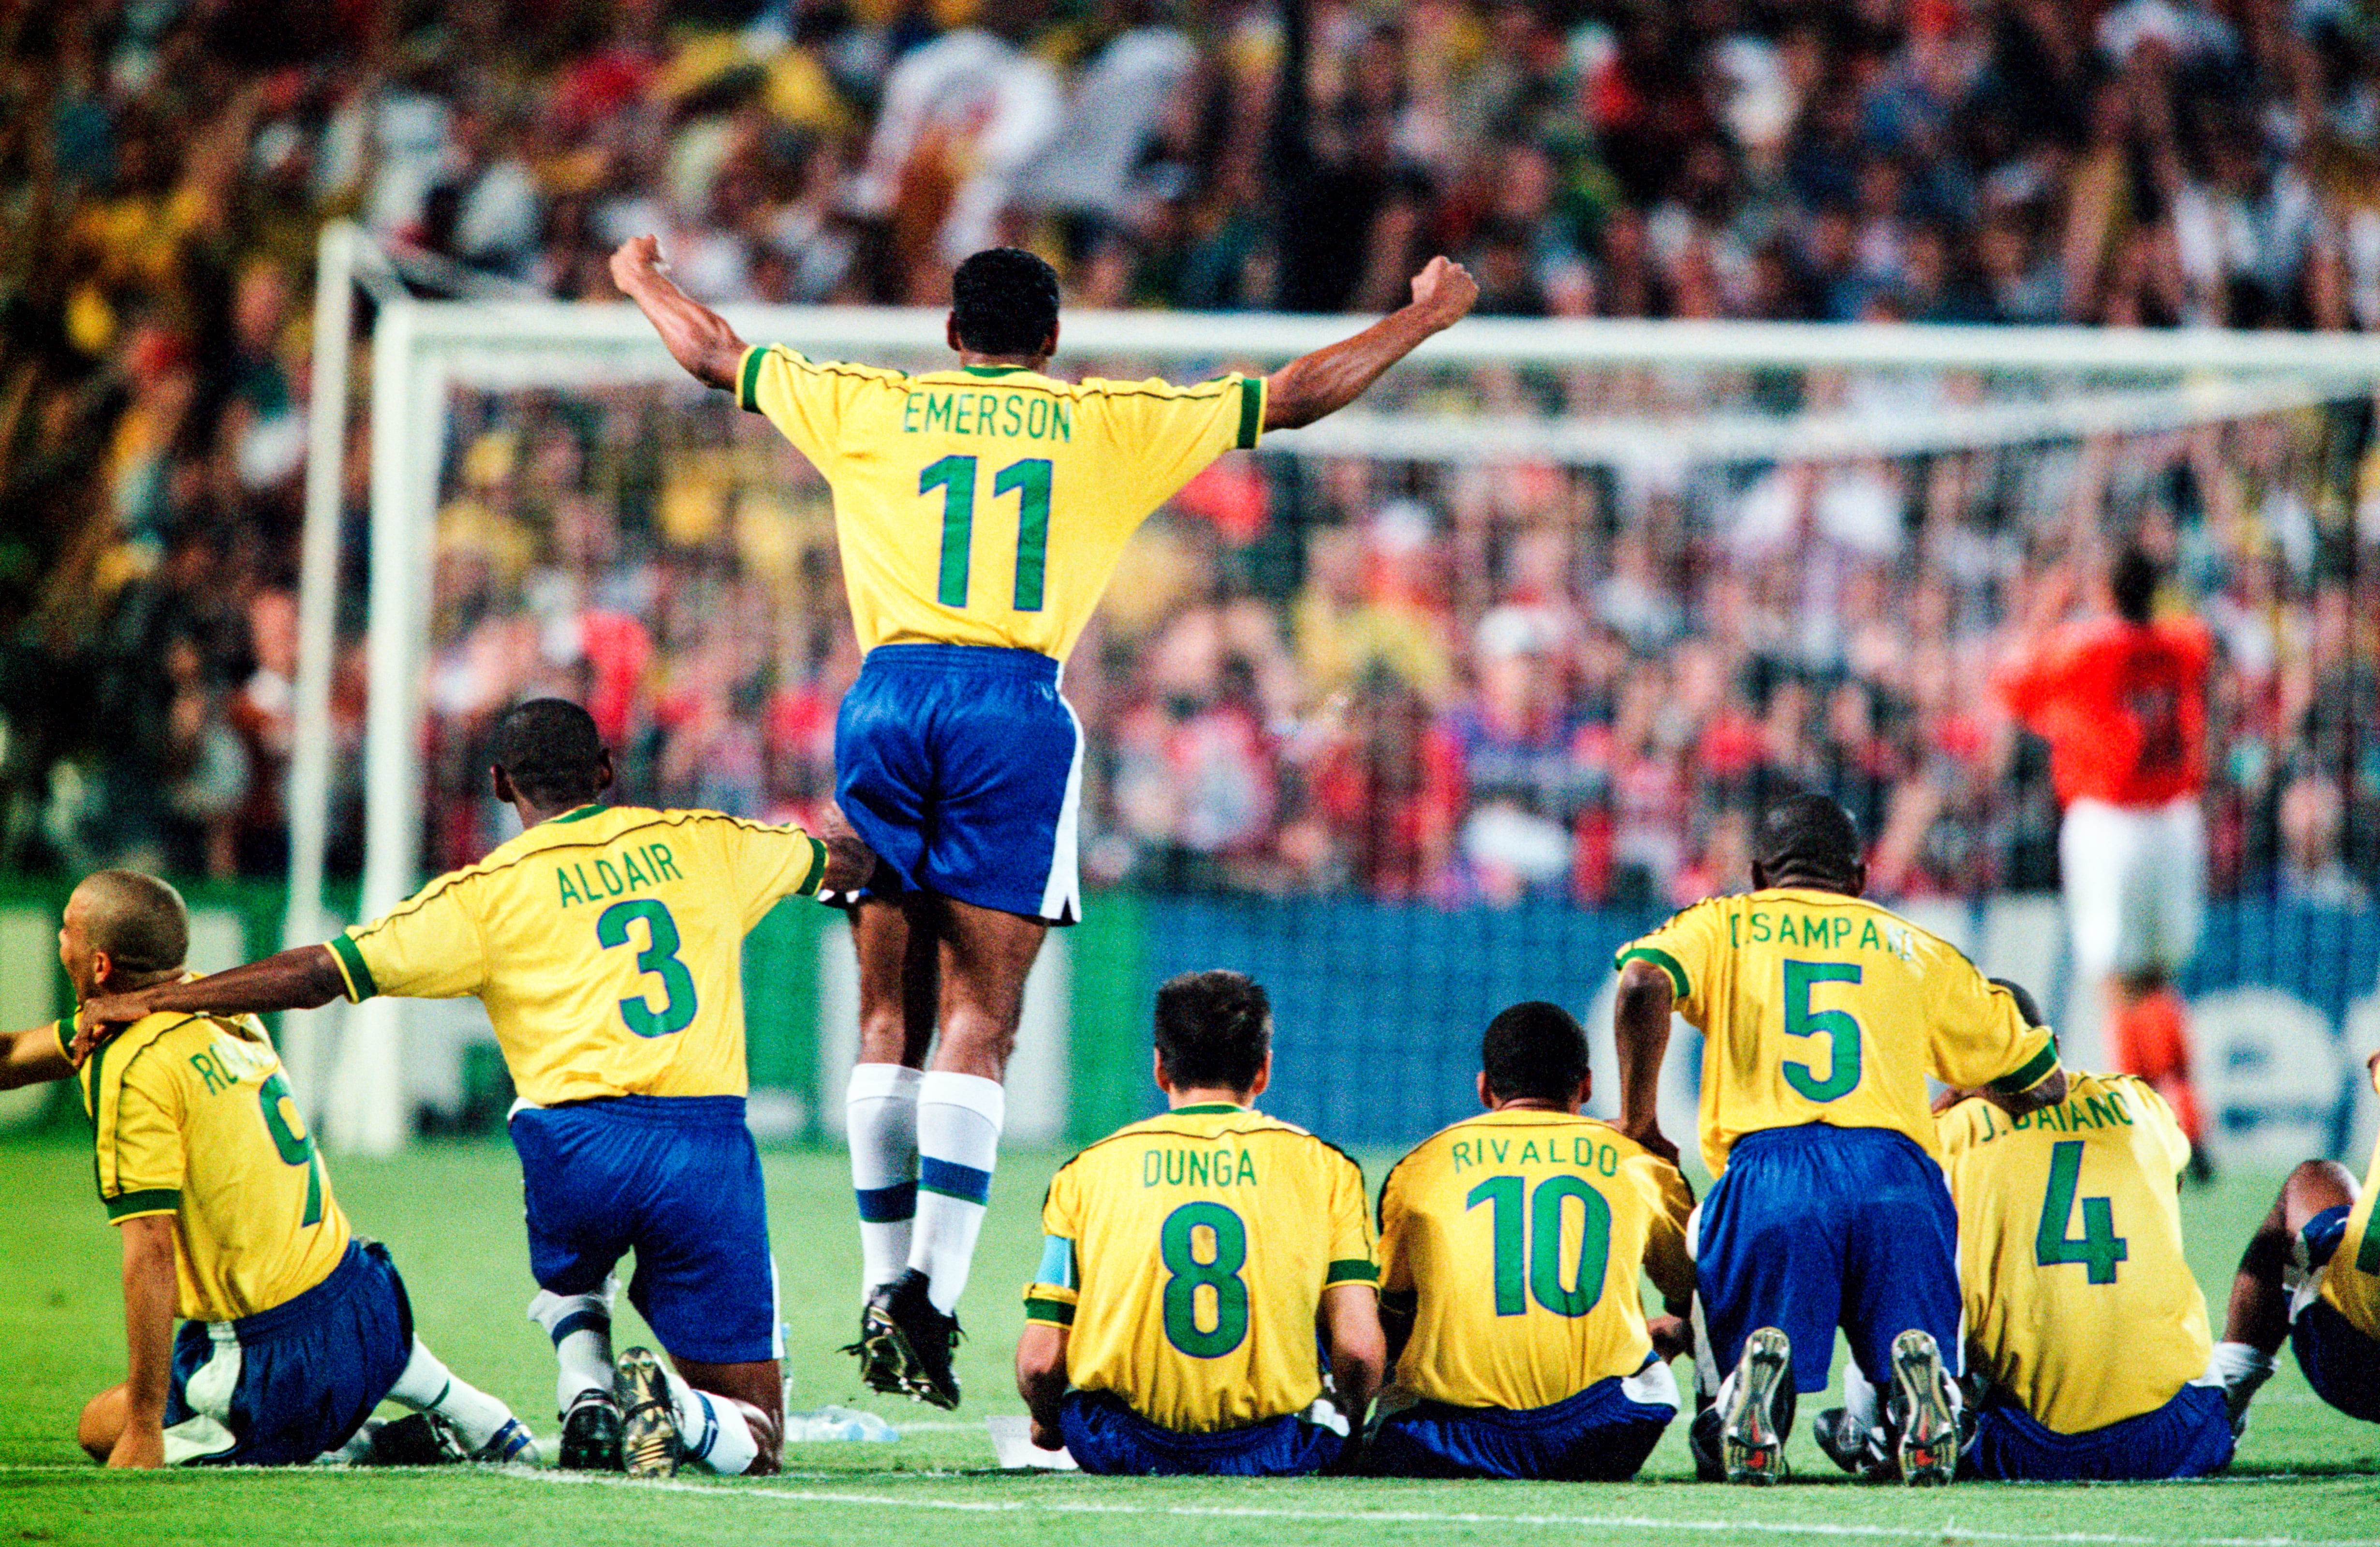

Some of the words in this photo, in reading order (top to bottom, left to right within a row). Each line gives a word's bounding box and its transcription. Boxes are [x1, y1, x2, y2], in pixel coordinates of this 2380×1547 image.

[904, 393, 1071, 443] EMERSON
[919, 455, 1053, 612] 11
[556, 843, 684, 908] ALDAIR
[596, 899, 698, 1038] 3
[1782, 958, 1862, 1103] 5
[258, 1073, 322, 1228] 9
[1144, 1149, 1257, 1188] DUNGA
[1451, 1137, 1618, 1177] RIVALDO
[2035, 1140, 2128, 1284] 4
[1161, 1201, 1249, 1359] 8
[1466, 1175, 1612, 1318] 10
